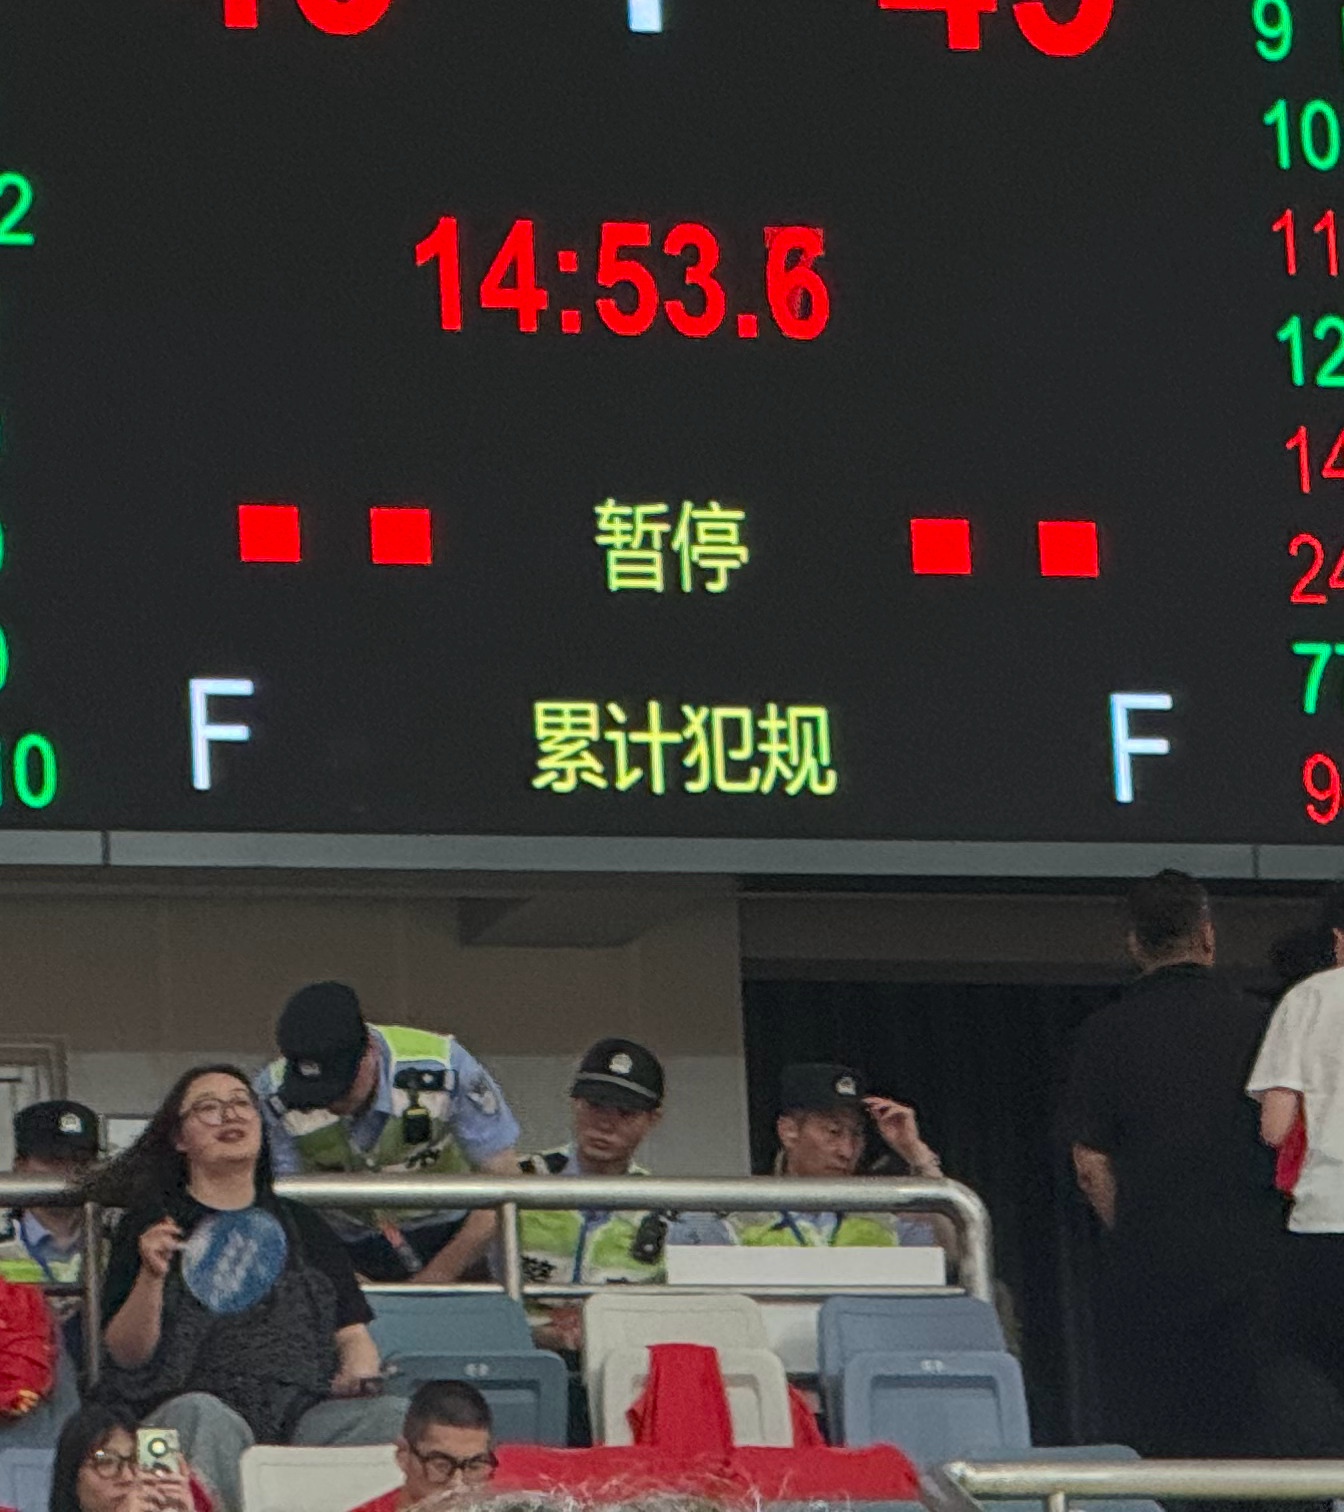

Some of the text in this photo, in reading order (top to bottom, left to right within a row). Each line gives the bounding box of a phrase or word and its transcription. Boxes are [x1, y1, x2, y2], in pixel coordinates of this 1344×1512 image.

[595, 498, 749, 592] 暂停
[189, 678, 254, 790] F
[532, 701, 837, 795] 累计犯规
[1110, 692, 1172, 803] F
